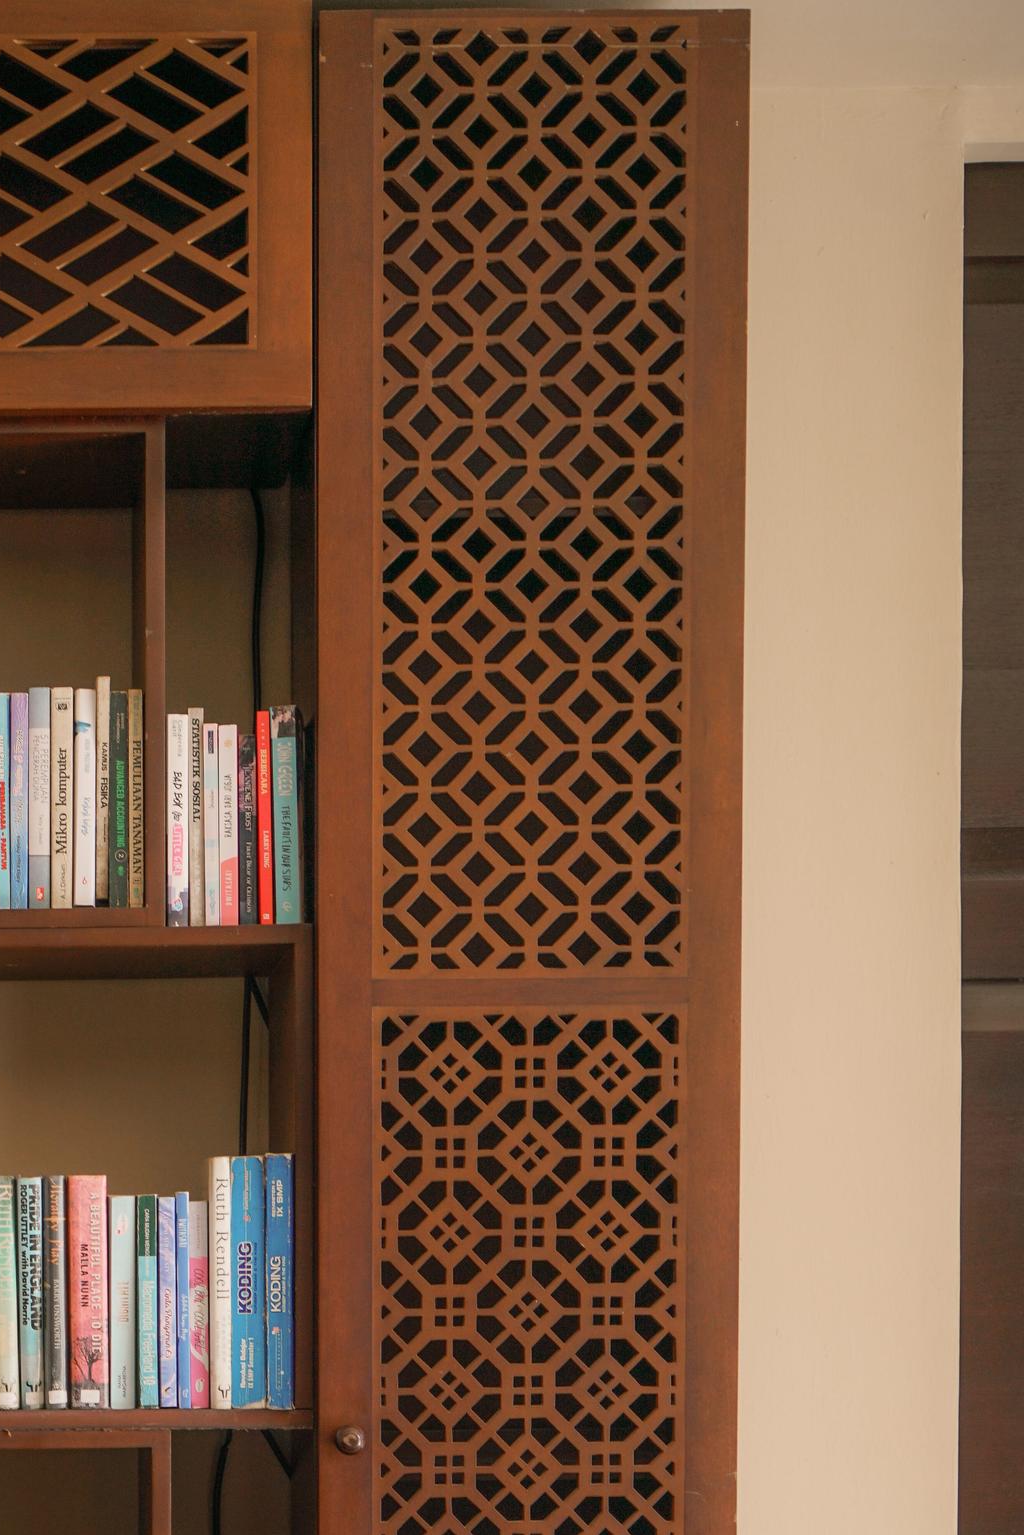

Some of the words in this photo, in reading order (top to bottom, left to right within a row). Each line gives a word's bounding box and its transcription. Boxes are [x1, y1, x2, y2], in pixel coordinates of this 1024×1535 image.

[133, 741, 141, 811] PEMULIAAN
[192, 719, 200, 777] STATISTIK
[55, 748, 69, 805] komputer
[100, 778, 108, 808] FISIKA
[116, 760, 124, 798] ADVANCED
[192, 781, 201, 822] SOSIAL
[56, 814, 67, 854] Mikro
[117, 802, 125, 847] ACCOUNTING
[133, 815, 142, 874] TANAMAN
[216, 1178, 228, 1221] Ruth
[217, 1231, 228, 1299] Rendell
[239, 1242, 252, 1314] KODING
[271, 1256, 281, 1312] KODING
